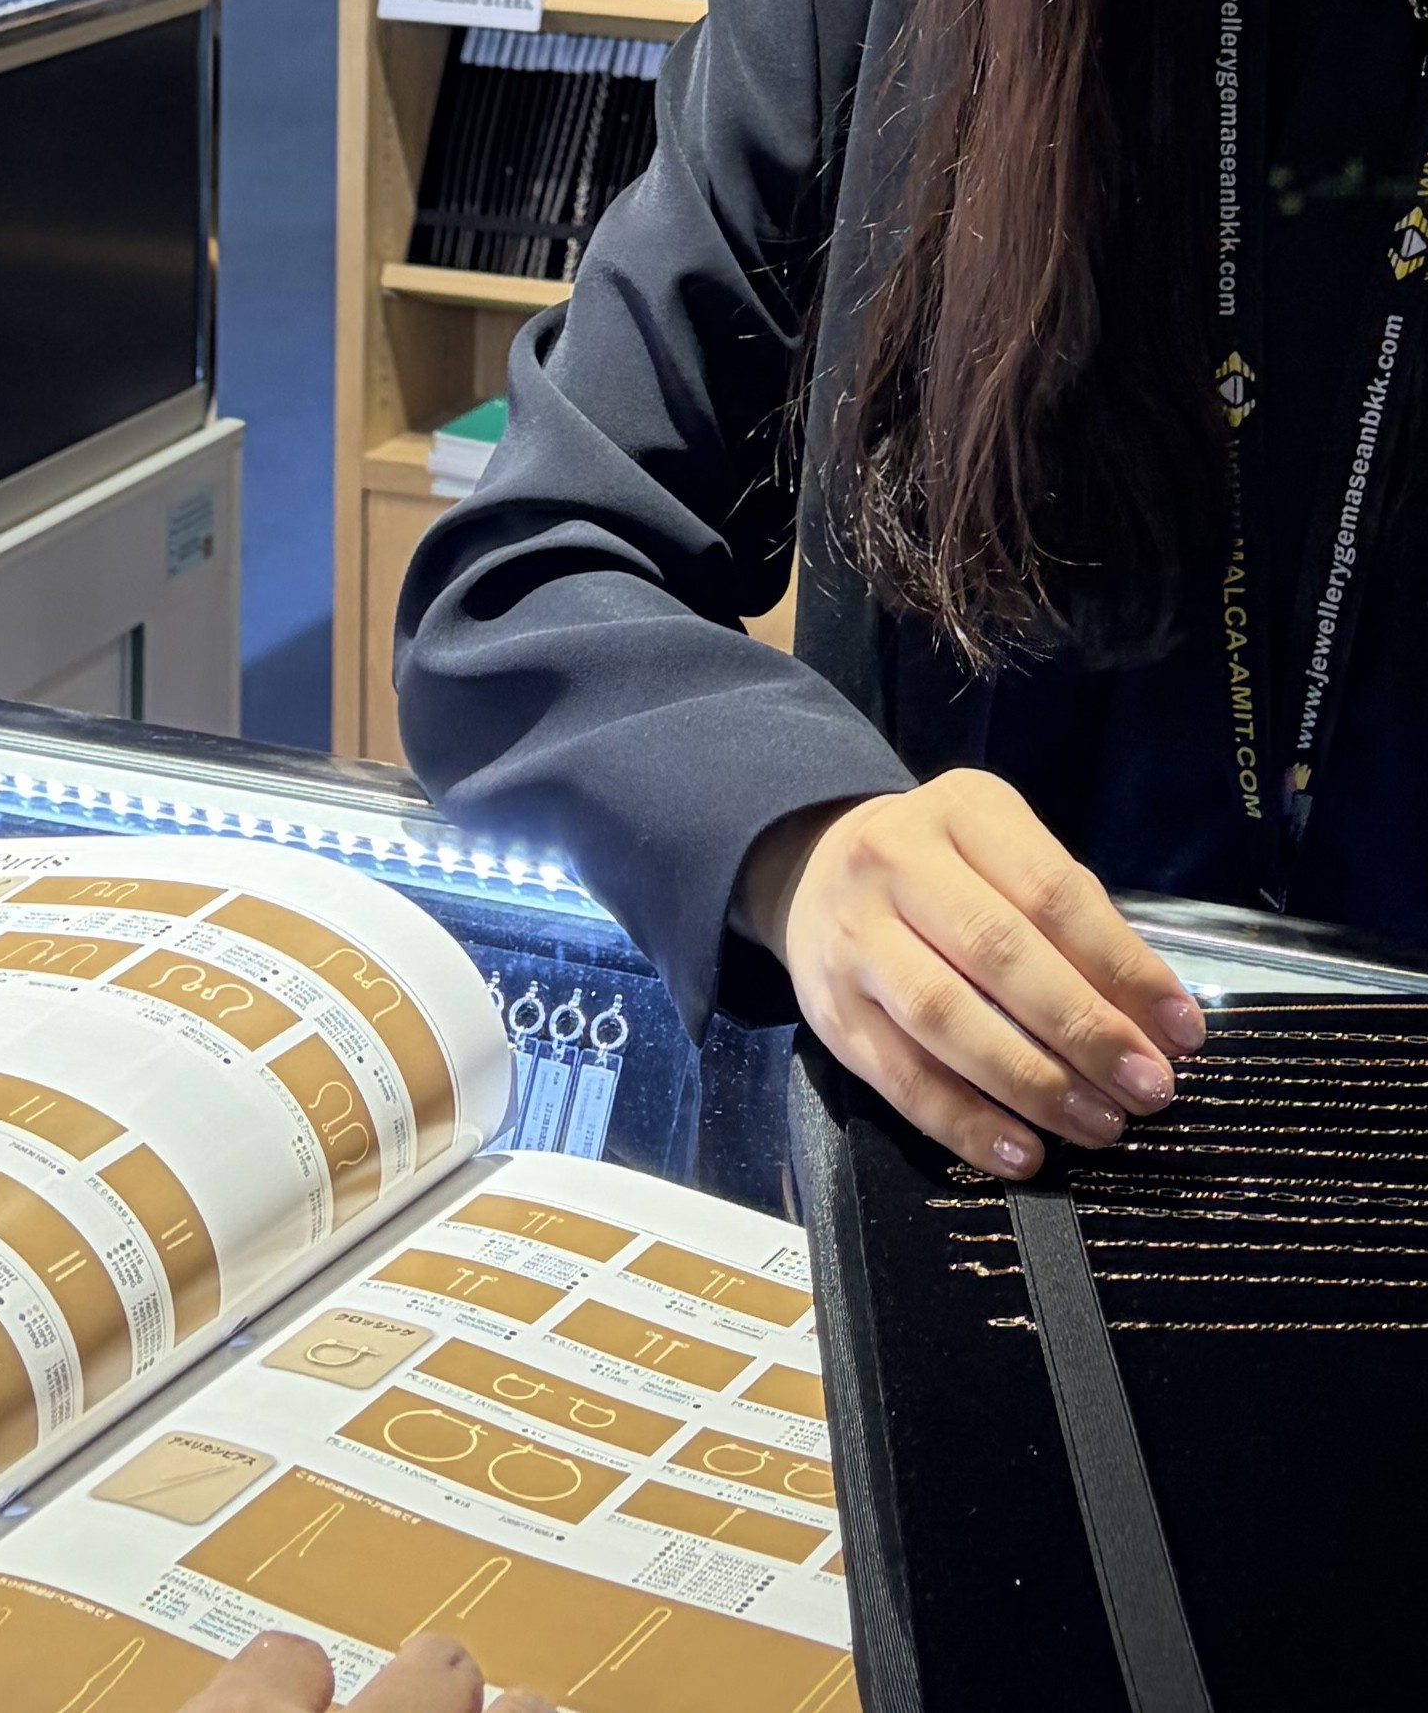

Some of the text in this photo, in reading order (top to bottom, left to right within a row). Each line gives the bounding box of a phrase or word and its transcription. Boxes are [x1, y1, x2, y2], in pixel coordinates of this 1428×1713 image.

[1297, 314, 1404, 750] www.jewellerygemaseanbkk.com
[334, 1311, 416, 1337] クロッシング
[167, 1435, 258, 1468] アメリカンピアス
